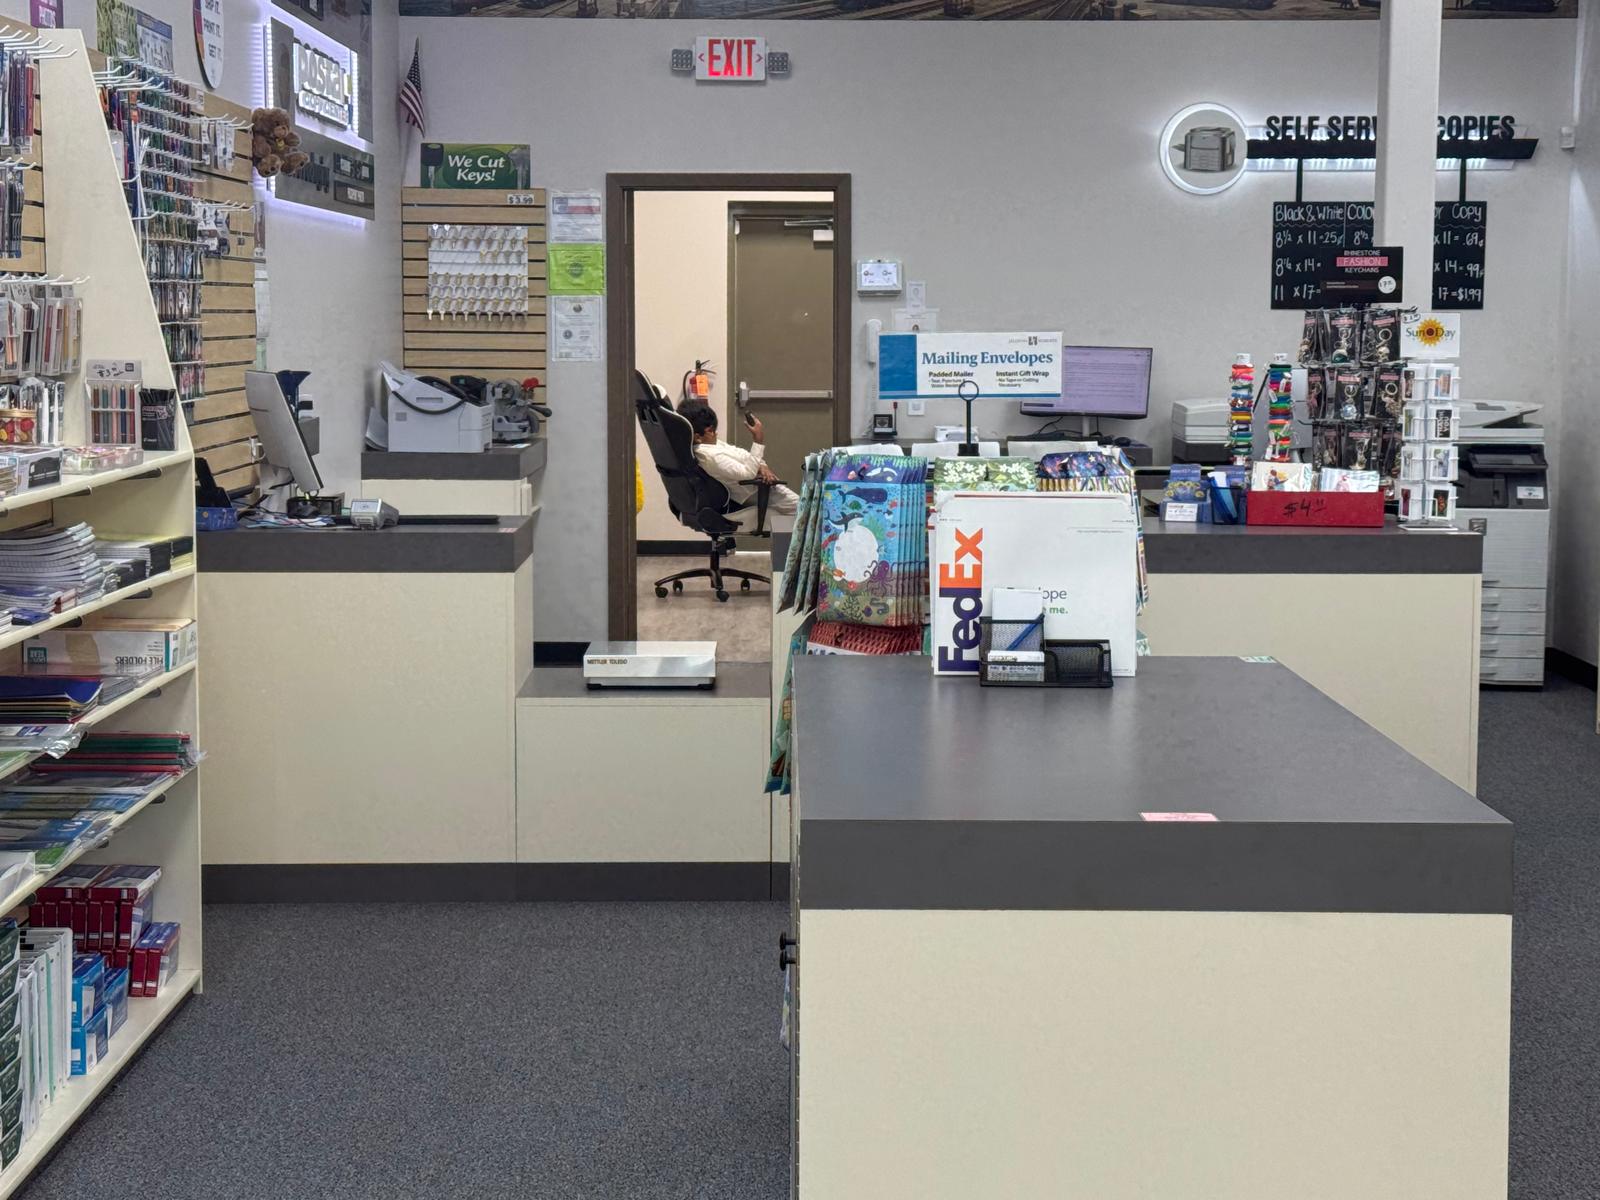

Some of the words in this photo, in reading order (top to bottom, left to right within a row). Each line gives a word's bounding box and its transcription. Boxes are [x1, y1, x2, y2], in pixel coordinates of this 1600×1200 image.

[708, 38, 757, 77] EXIT
[1266, 115, 1320, 140] SELF
[448, 154, 473, 168] We
[477, 155, 506, 168] Cut
[456, 168, 496, 185] Keys!
[1451, 203, 1482, 222] Copy
[1343, 257, 1382, 267] FASHION
[1405, 327, 1425, 338] Sun
[1435, 327, 1456, 340] Day
[922, 351, 978, 367] Mailing
[981, 350, 1053, 367] Envelopes
[929, 370, 953, 378] Padded
[953, 370, 974, 378] Mailer
[1032, 370, 1050, 378] Wrap
[938, 528, 983, 672] FedEx
[115, 656, 148, 665] FOLDERS
